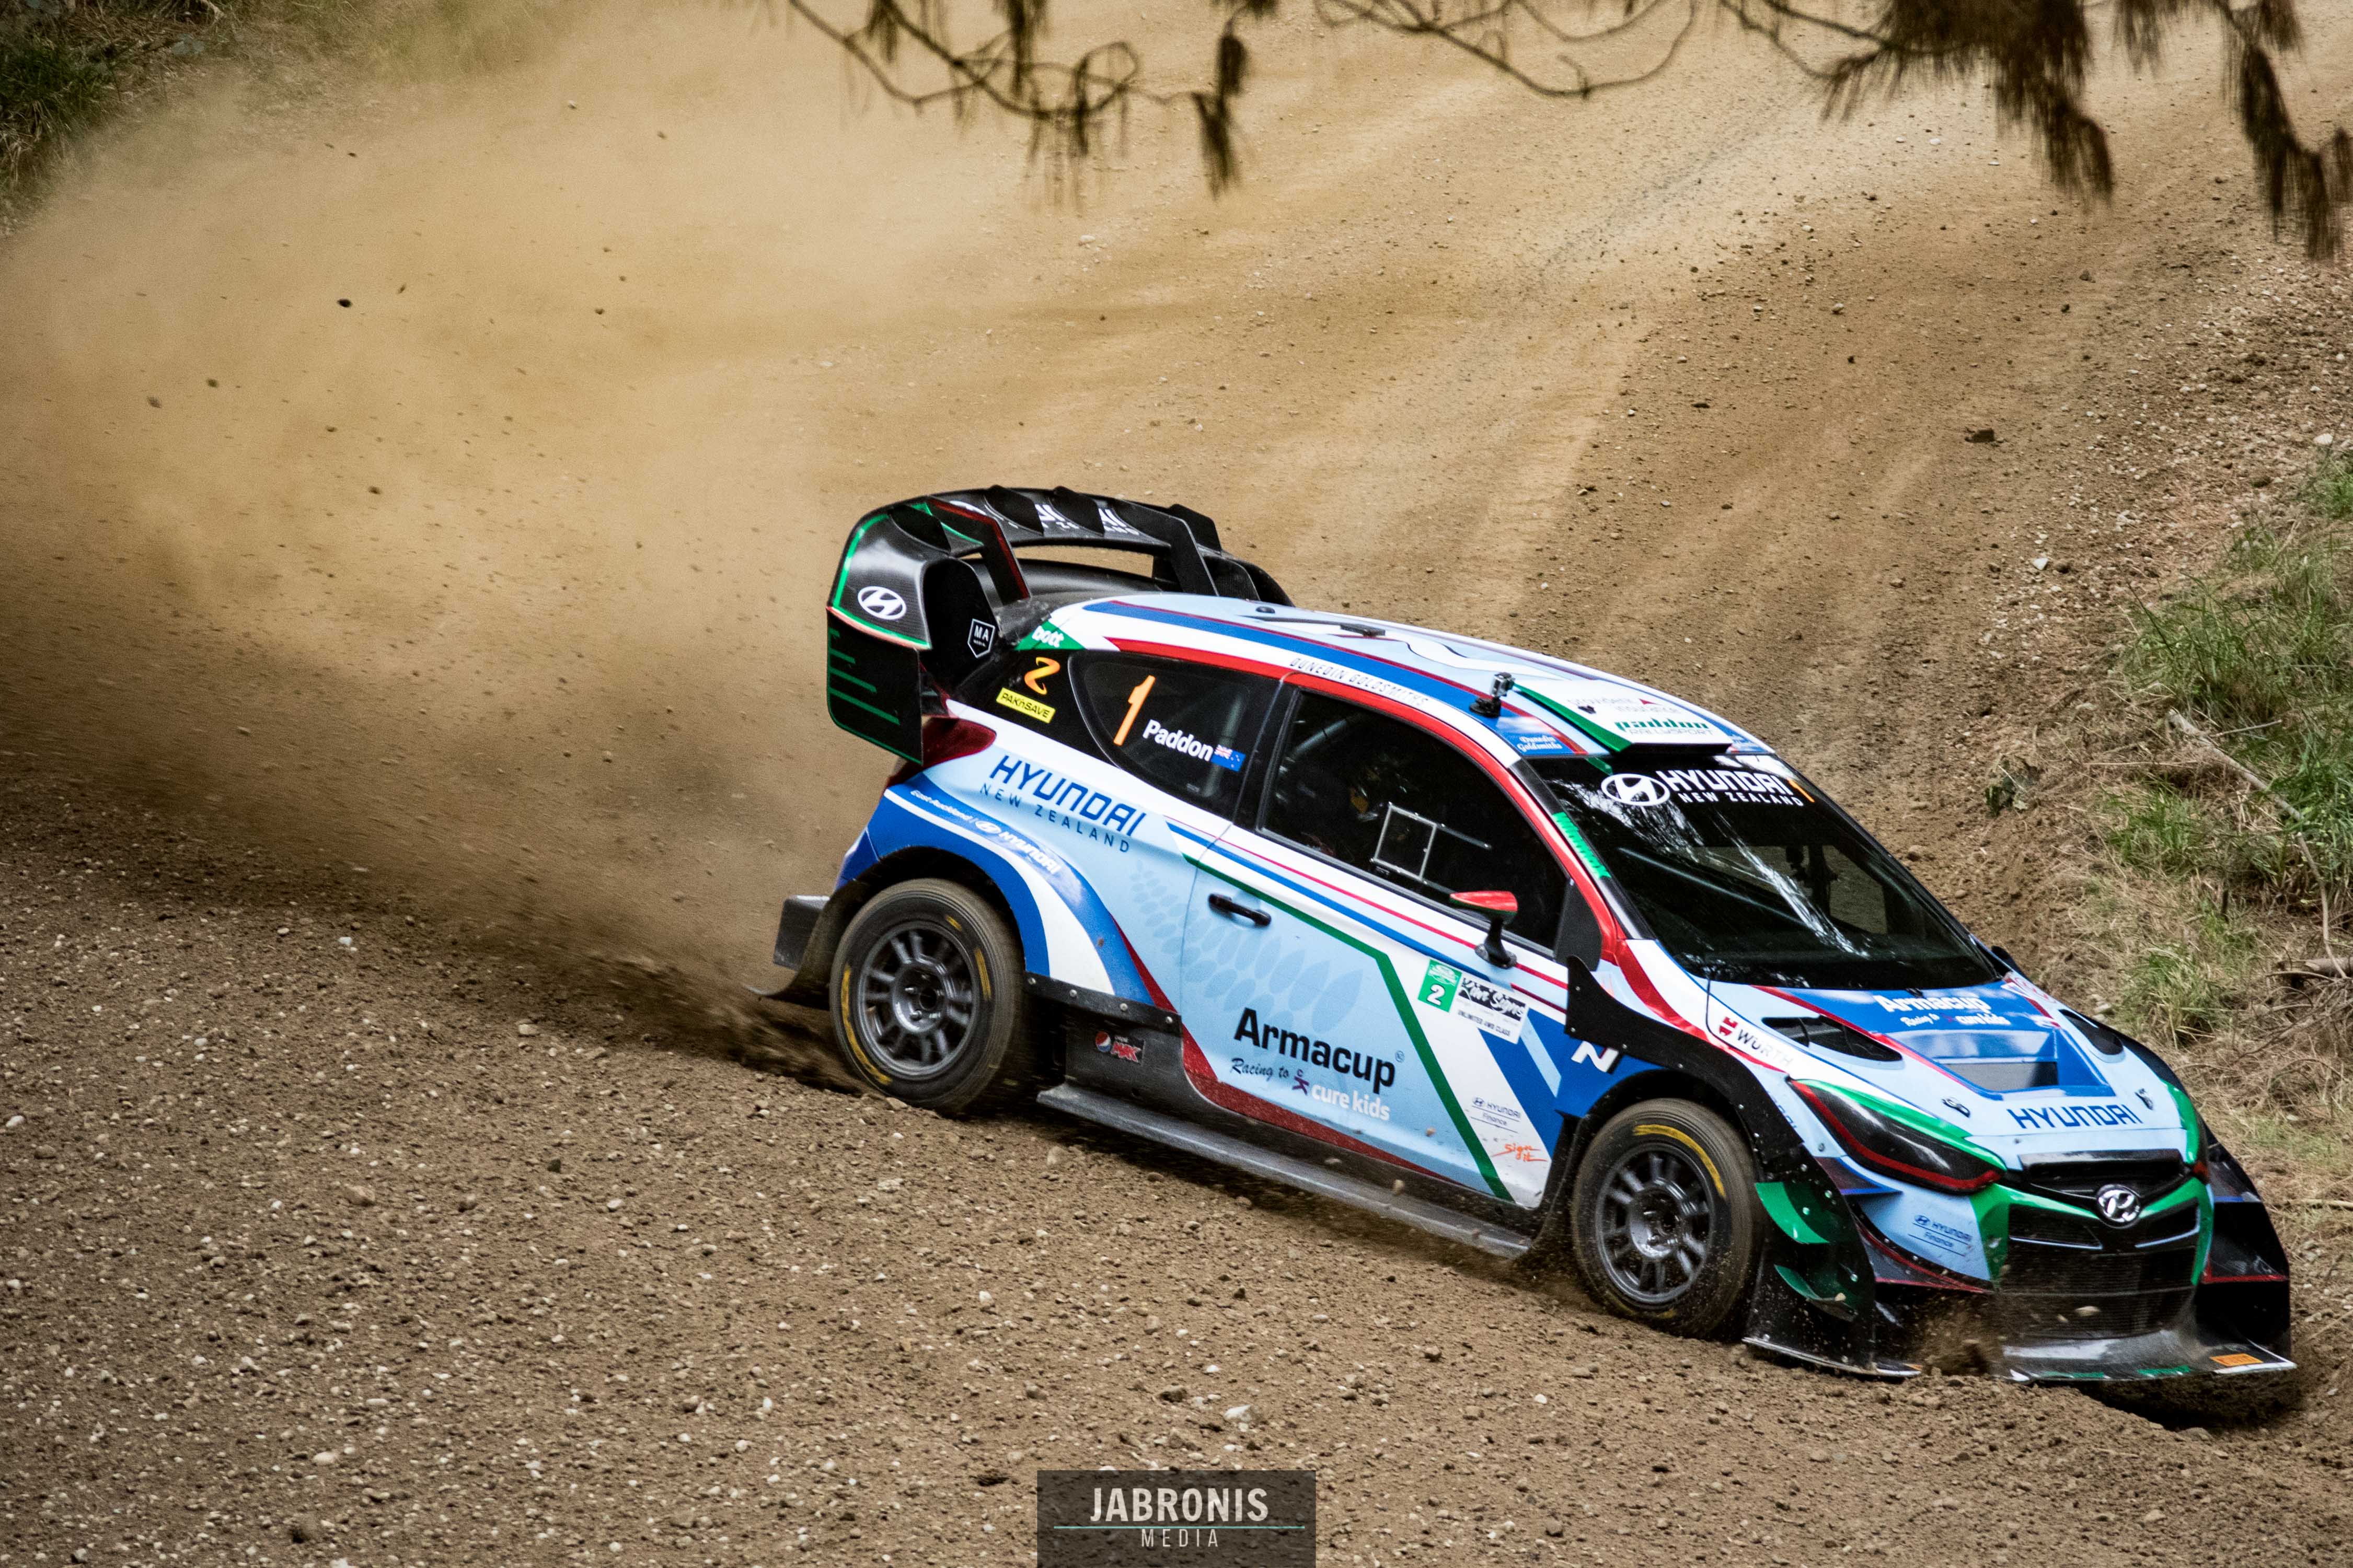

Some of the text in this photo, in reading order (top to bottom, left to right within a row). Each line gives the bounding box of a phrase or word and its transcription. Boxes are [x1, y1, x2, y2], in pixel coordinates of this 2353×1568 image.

[974, 625, 989, 641] MA
[1113, 675, 1156, 746] 1
[1142, 719, 1214, 762] Paddon
[1655, 770, 1794, 796] HYUNDAI
[989, 756, 1147, 836] HYUNDAI
[1678, 792, 1804, 806] NEW ZEALAND
[980, 783, 1129, 853] NEW ZEALAND
[998, 831, 1062, 874] HYUNDAI
[1426, 984, 1446, 1006] 2
[1873, 995, 1992, 1013] Armacup
[1229, 1057, 1274, 1082] Racing
[1279, 1065, 1289, 1078] to
[1311, 1083, 1349, 1109] cure
[1352, 1090, 1390, 1121] kids
[1483, 1112, 1507, 1125] Finance
[1486, 1102, 1520, 1118] HYUNDAI
[2007, 1104, 2143, 1129] HYUNDAI
[1924, 1232, 1953, 1247] Finance
[1932, 1222, 1973, 1242] HYUNDAI
